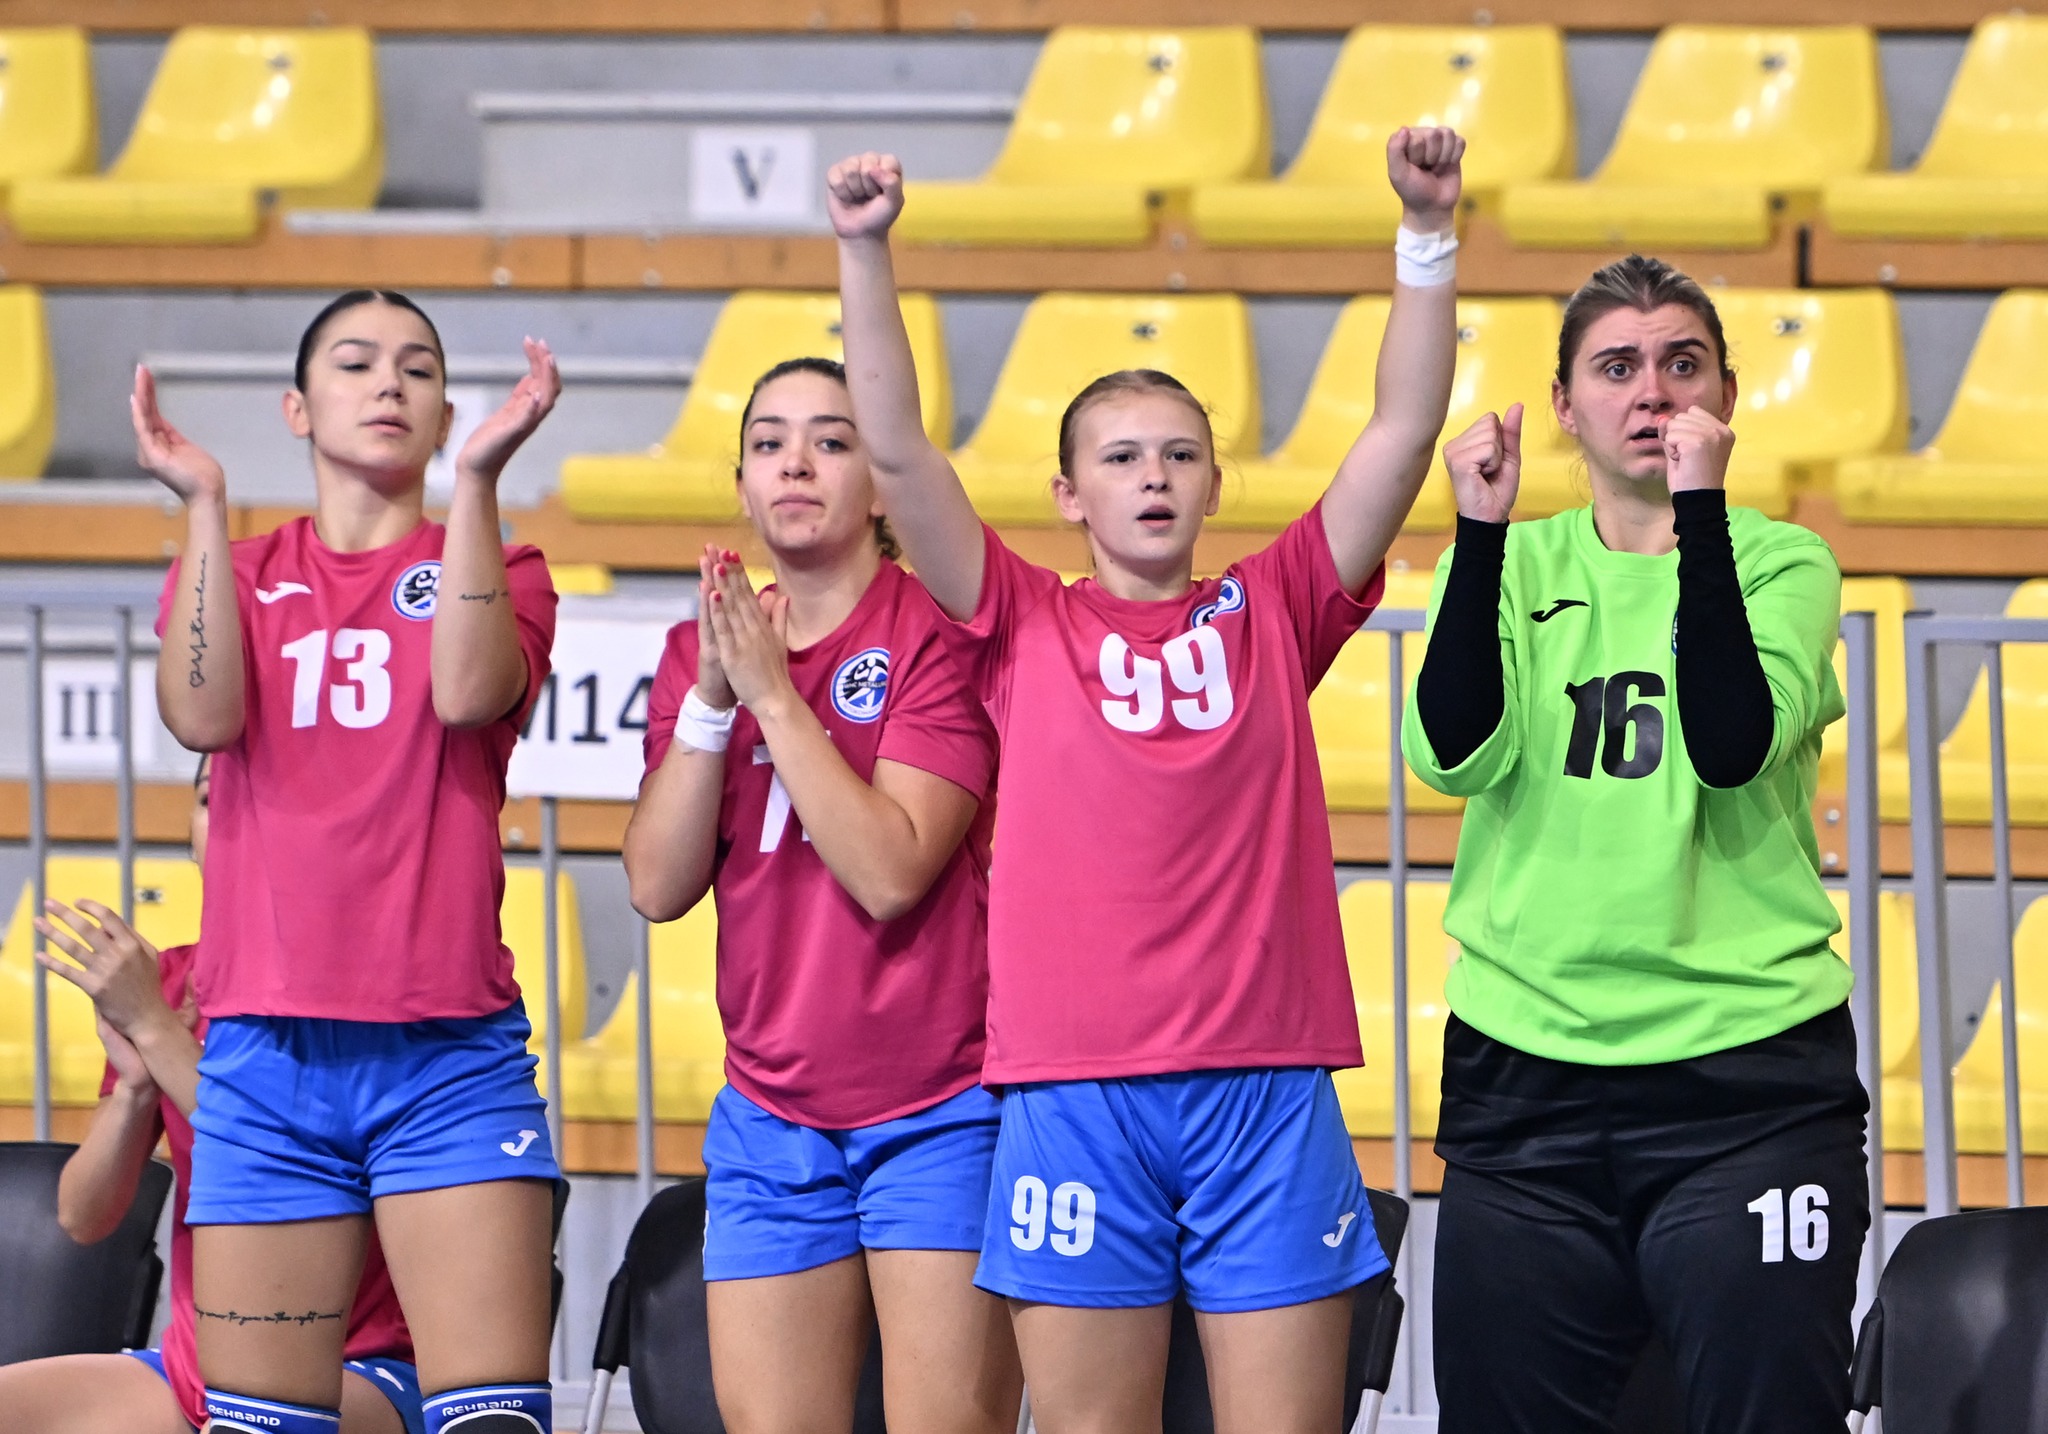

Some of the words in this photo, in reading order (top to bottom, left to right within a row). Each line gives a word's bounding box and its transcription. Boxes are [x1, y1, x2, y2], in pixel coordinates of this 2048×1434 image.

[731, 146, 777, 201] V
[281, 627, 392, 729] 13
[1099, 625, 1234, 732] 99
[1563, 671, 1666, 780] 16
[1009, 1175, 1097, 1257] 99
[1747, 1184, 1830, 1263] 16
[207, 1404, 281, 1427] REHBAND
[442, 1399, 523, 1417] REHBAND
